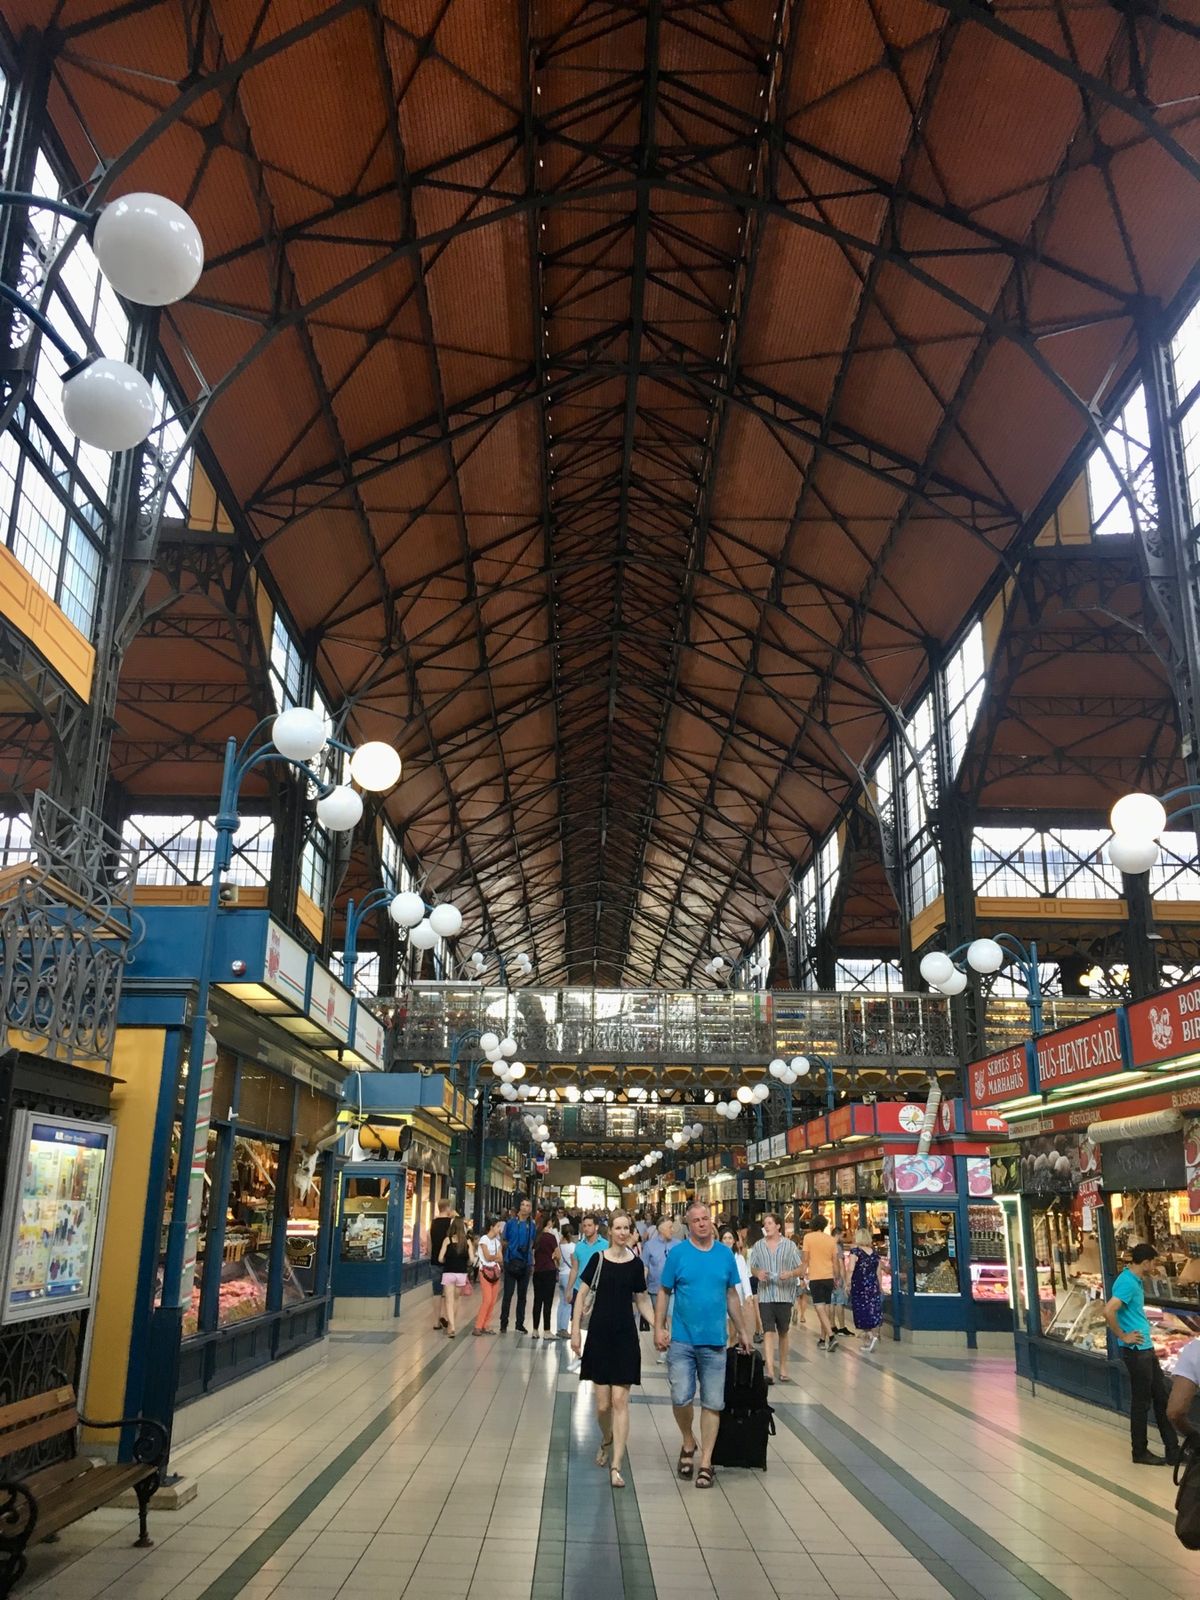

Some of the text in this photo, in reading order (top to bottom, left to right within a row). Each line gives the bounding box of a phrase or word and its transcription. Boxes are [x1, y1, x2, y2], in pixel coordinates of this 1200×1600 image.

[987, 1050, 1022, 1077] SERTÉS ÉS
[988, 1068, 1024, 1096] MARHAHÚS
